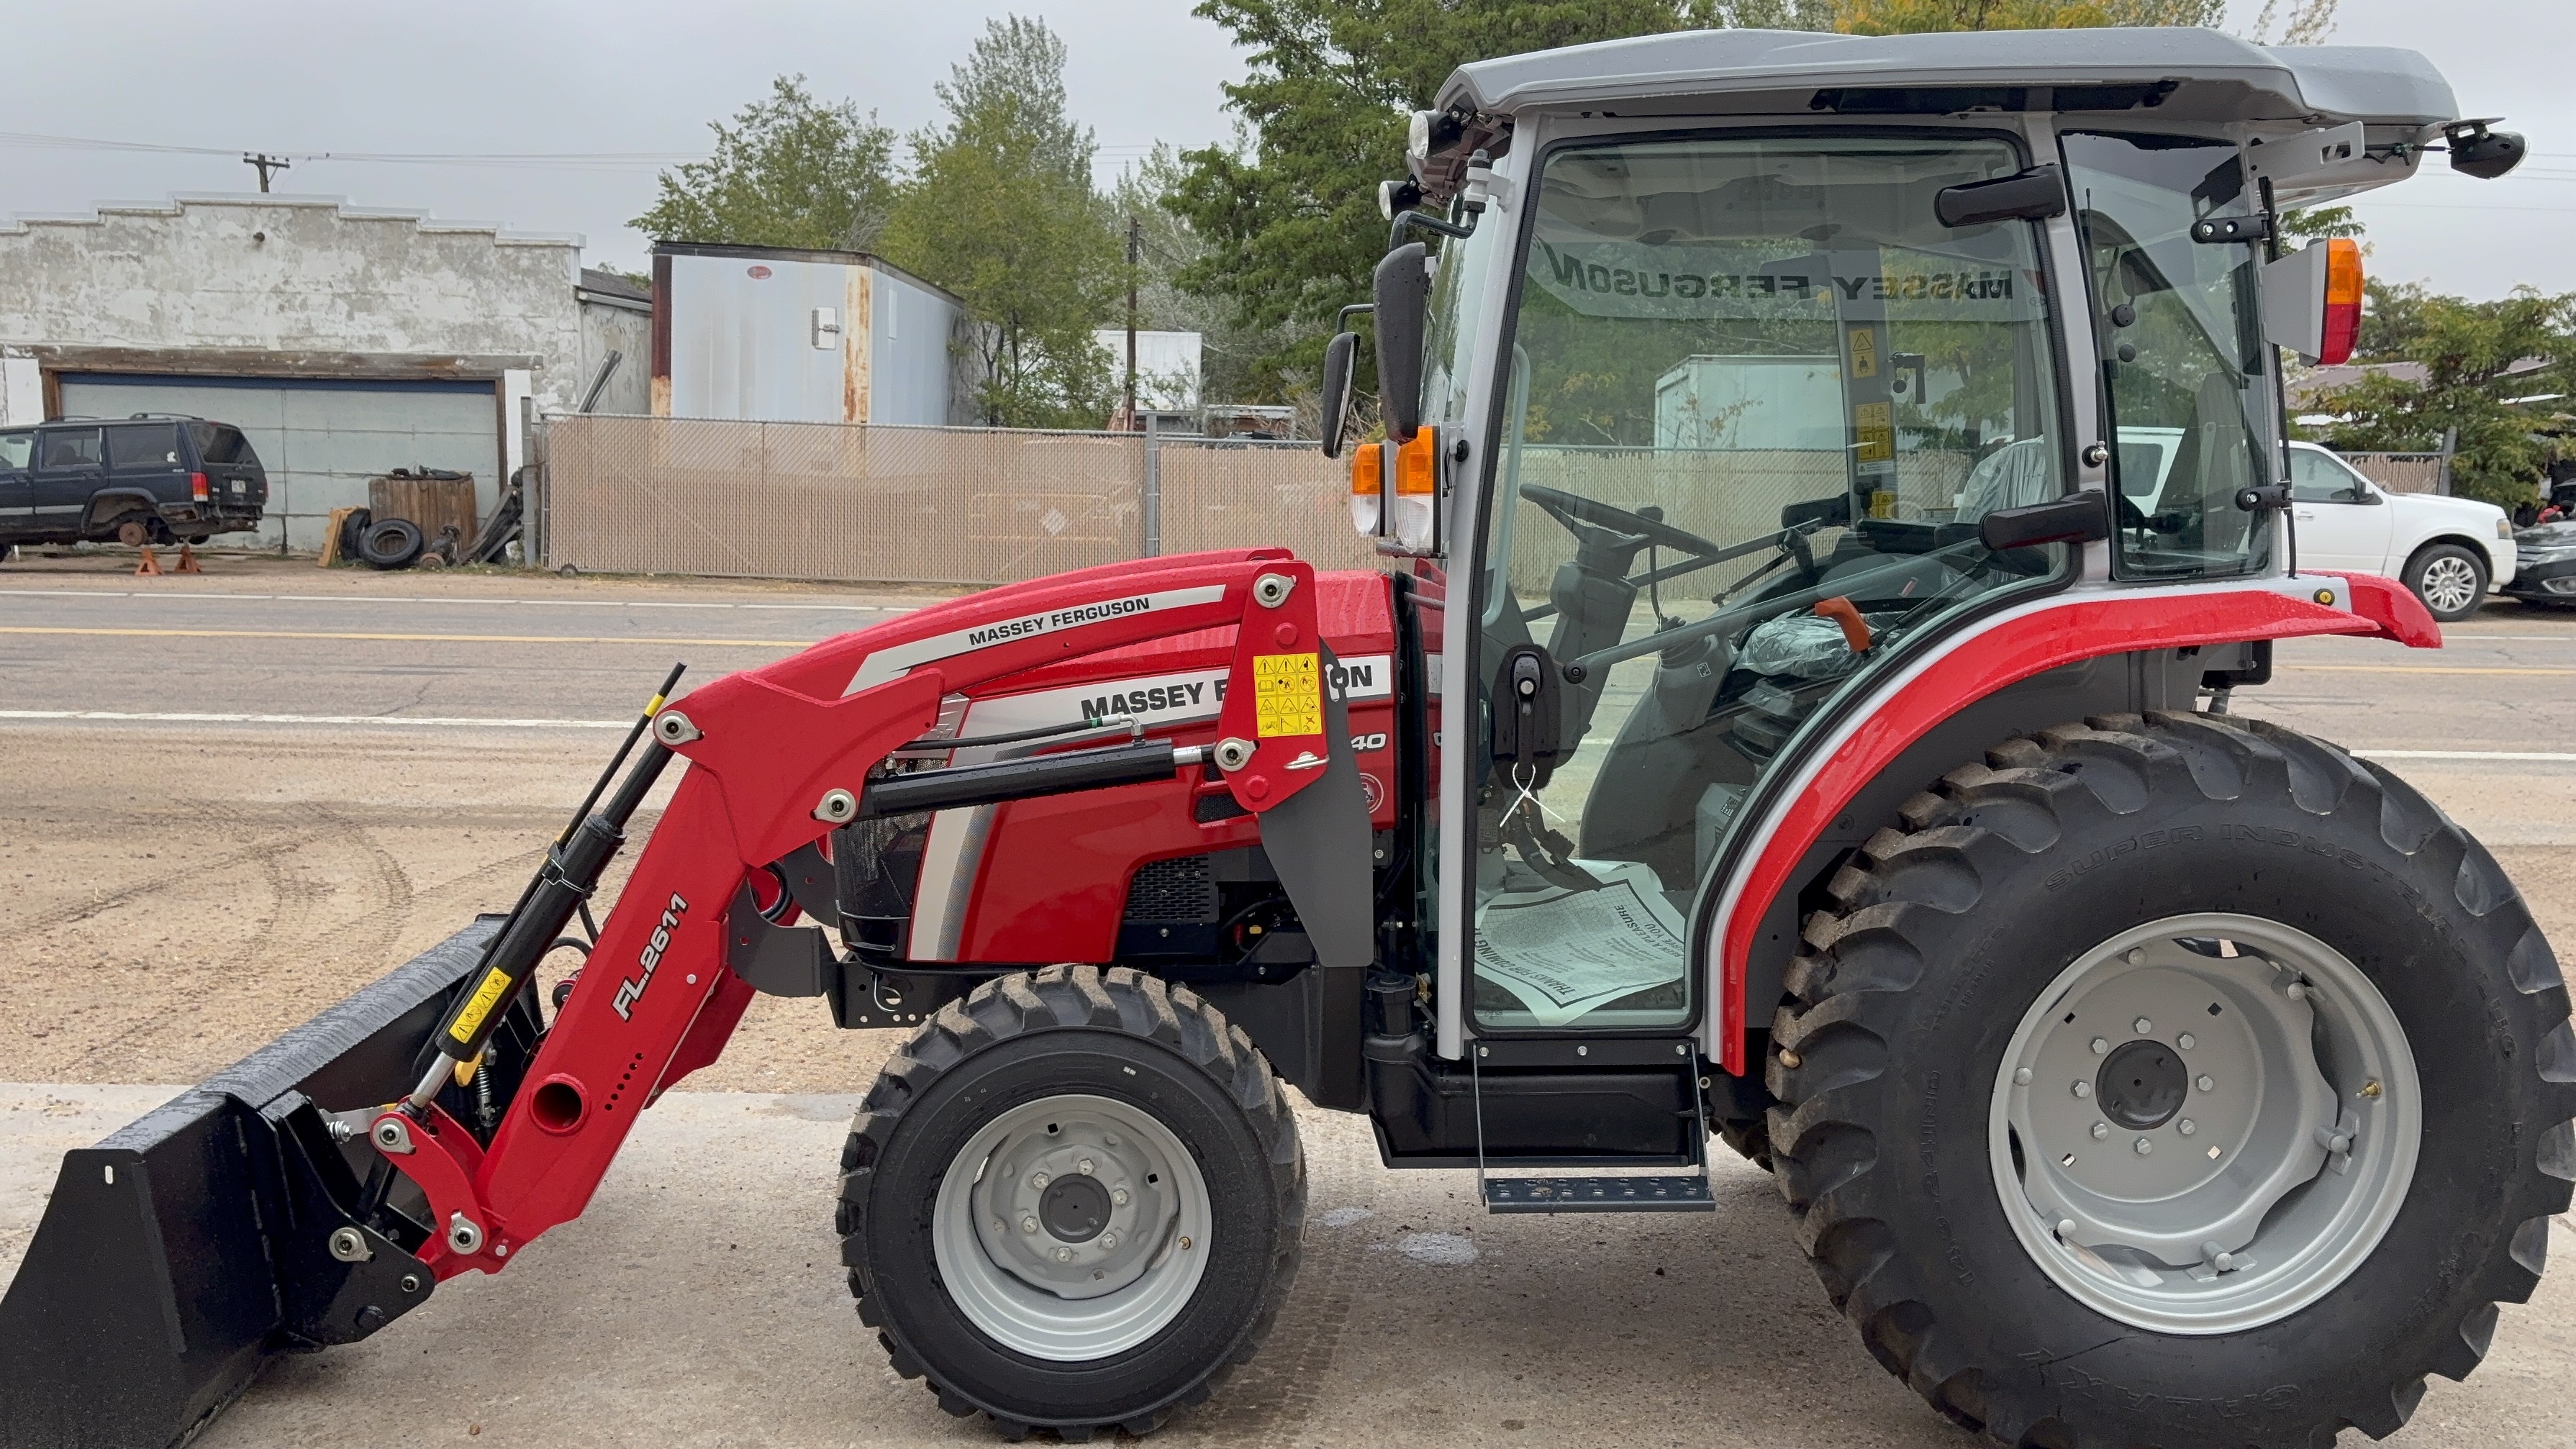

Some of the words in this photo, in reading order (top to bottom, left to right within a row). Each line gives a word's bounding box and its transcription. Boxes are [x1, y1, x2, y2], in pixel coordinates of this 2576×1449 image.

[969, 617, 1044, 646] MASSEY
[1051, 596, 1151, 627] FERGUSON
[1081, 681, 1204, 720] MASSEY
[1613, 904, 1656, 943] PLEASURE
[1644, 923, 1665, 939] YOU
[1474, 939, 1516, 968] COMING
[1528, 973, 1576, 996] THANKS
[2015, 1347, 2302, 1418] GALAXY
